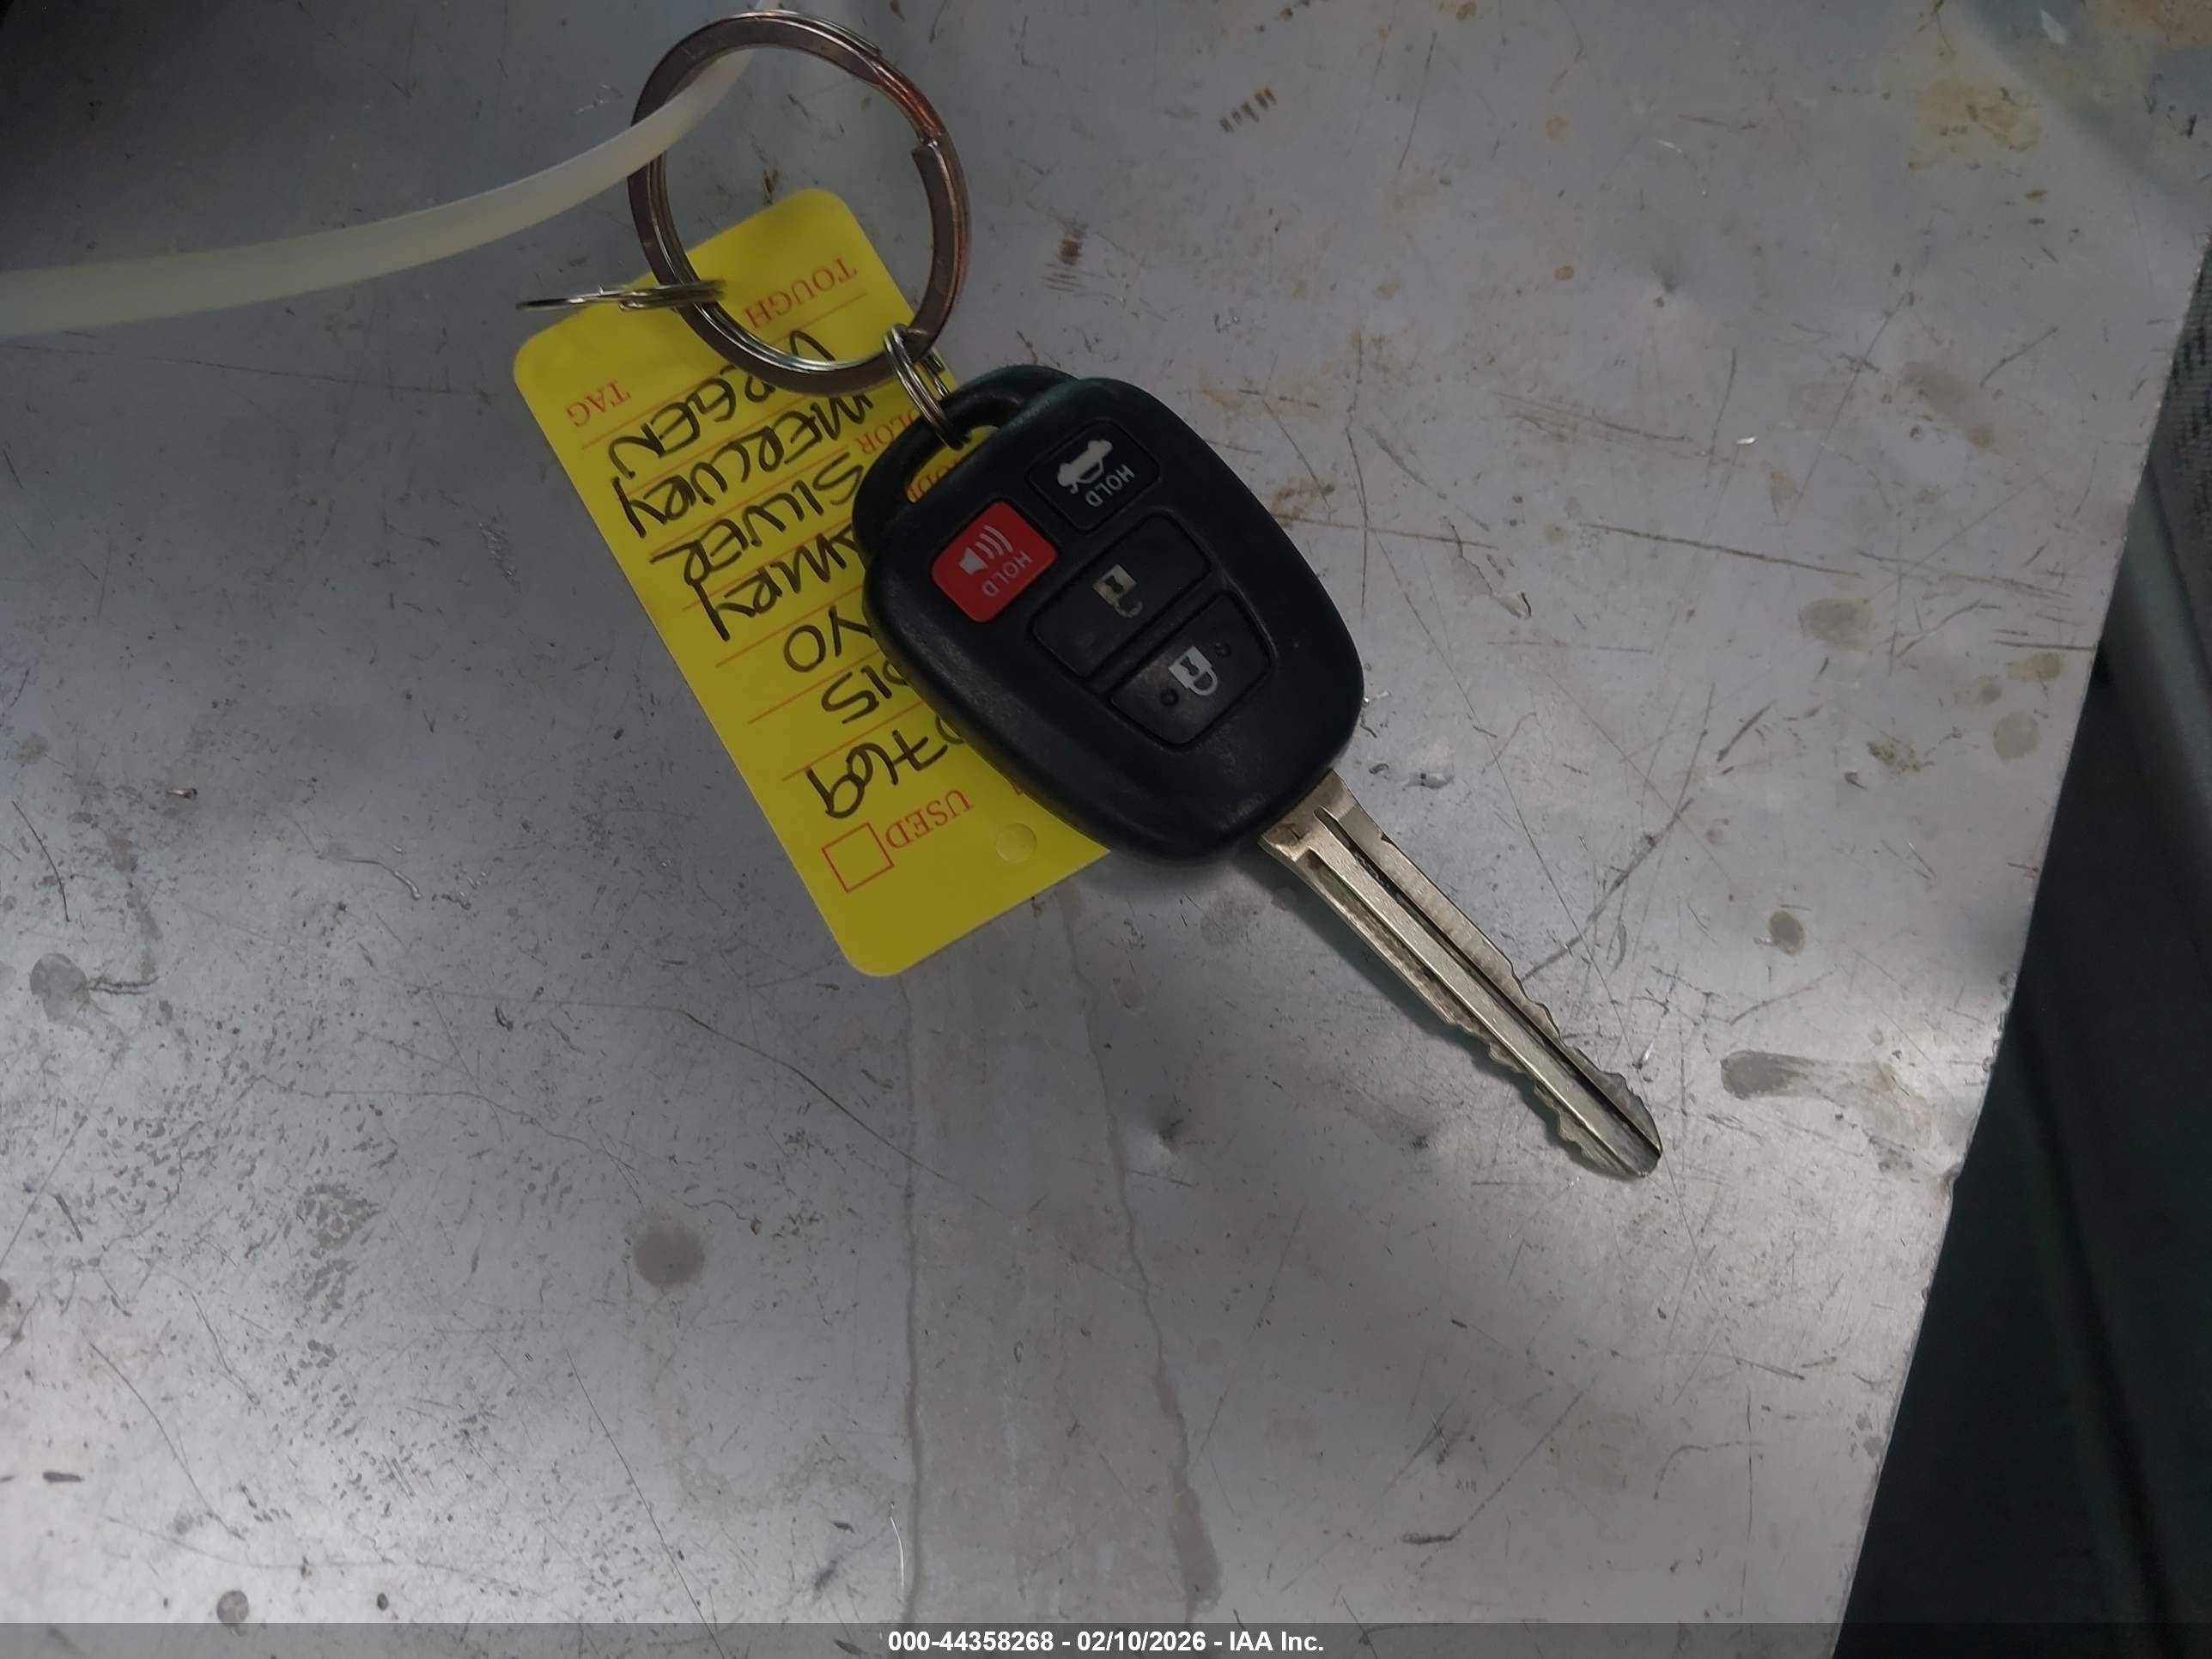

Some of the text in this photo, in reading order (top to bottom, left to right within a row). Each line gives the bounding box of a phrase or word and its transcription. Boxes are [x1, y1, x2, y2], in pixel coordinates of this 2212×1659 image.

[565, 257, 857, 428] TOUGH TAG
[608, 331, 836, 480] VRGEN
[611, 392, 874, 538] MERCURY
[649, 452, 864, 586] SILVER
[1085, 464, 1135, 507] HOLD
[981, 550, 1033, 597] HOLD
[884, 789, 974, 848] USED
